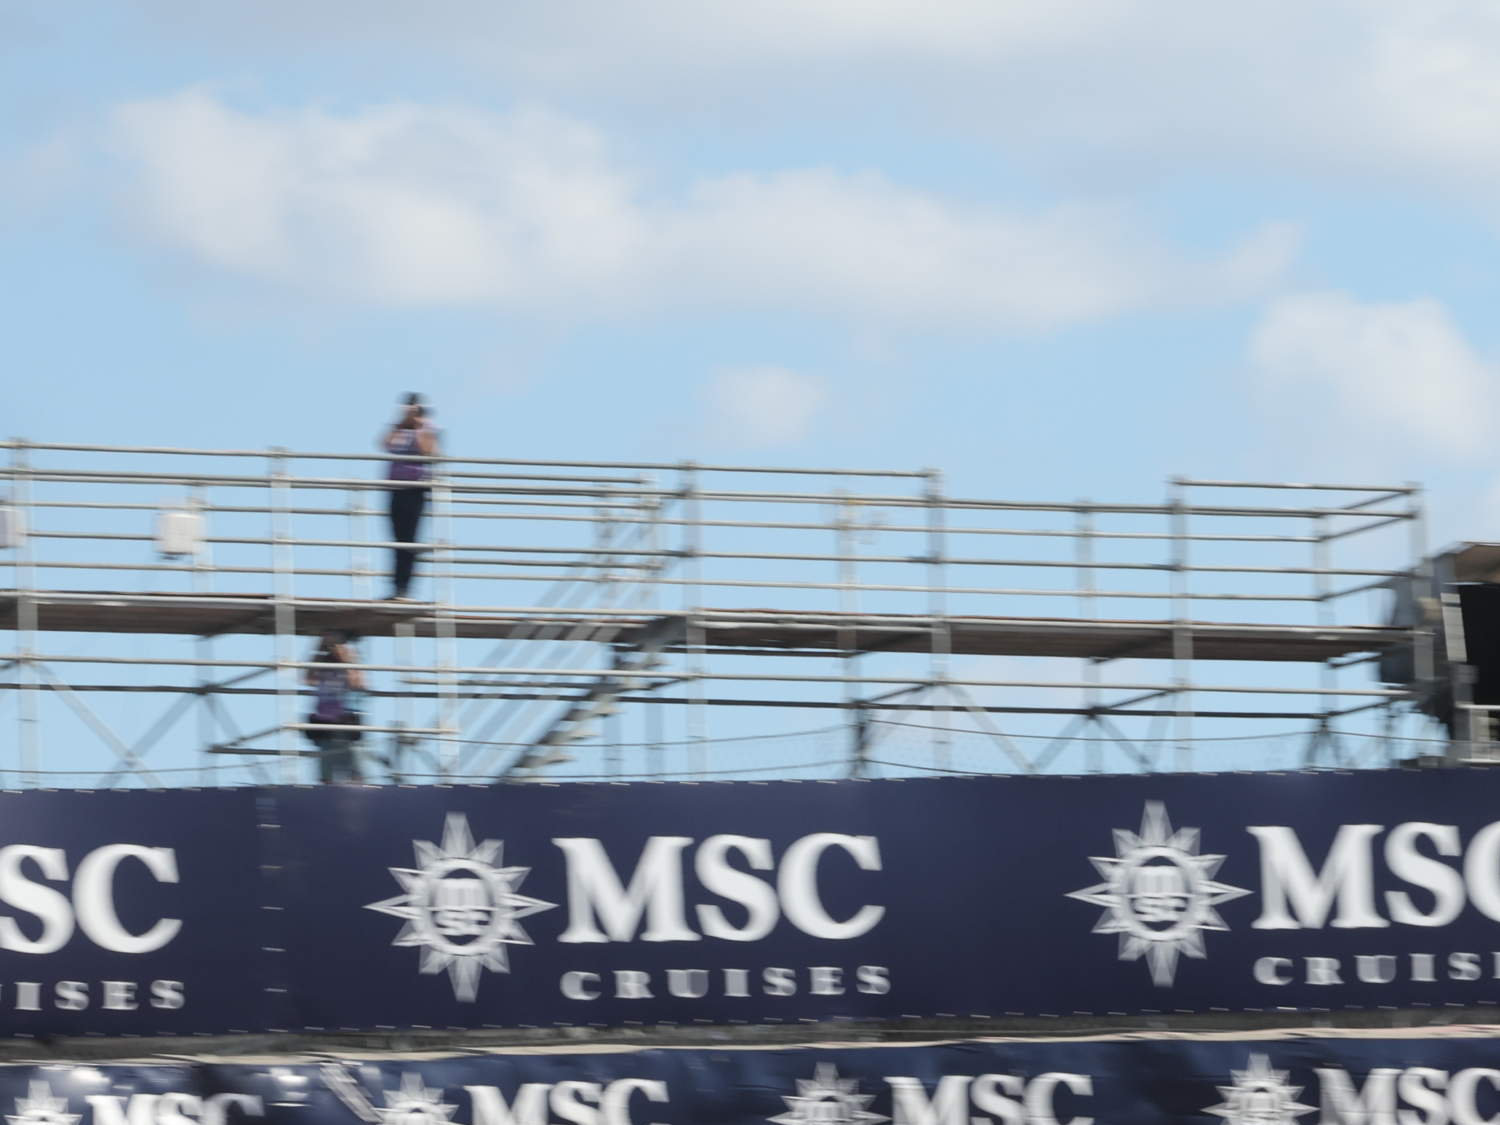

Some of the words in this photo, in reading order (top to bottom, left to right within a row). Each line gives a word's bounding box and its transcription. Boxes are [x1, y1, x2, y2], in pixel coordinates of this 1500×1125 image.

[552, 833, 886, 944] MSC
[0, 979, 185, 1011] ISES
[560, 965, 890, 1001] CRUISES
